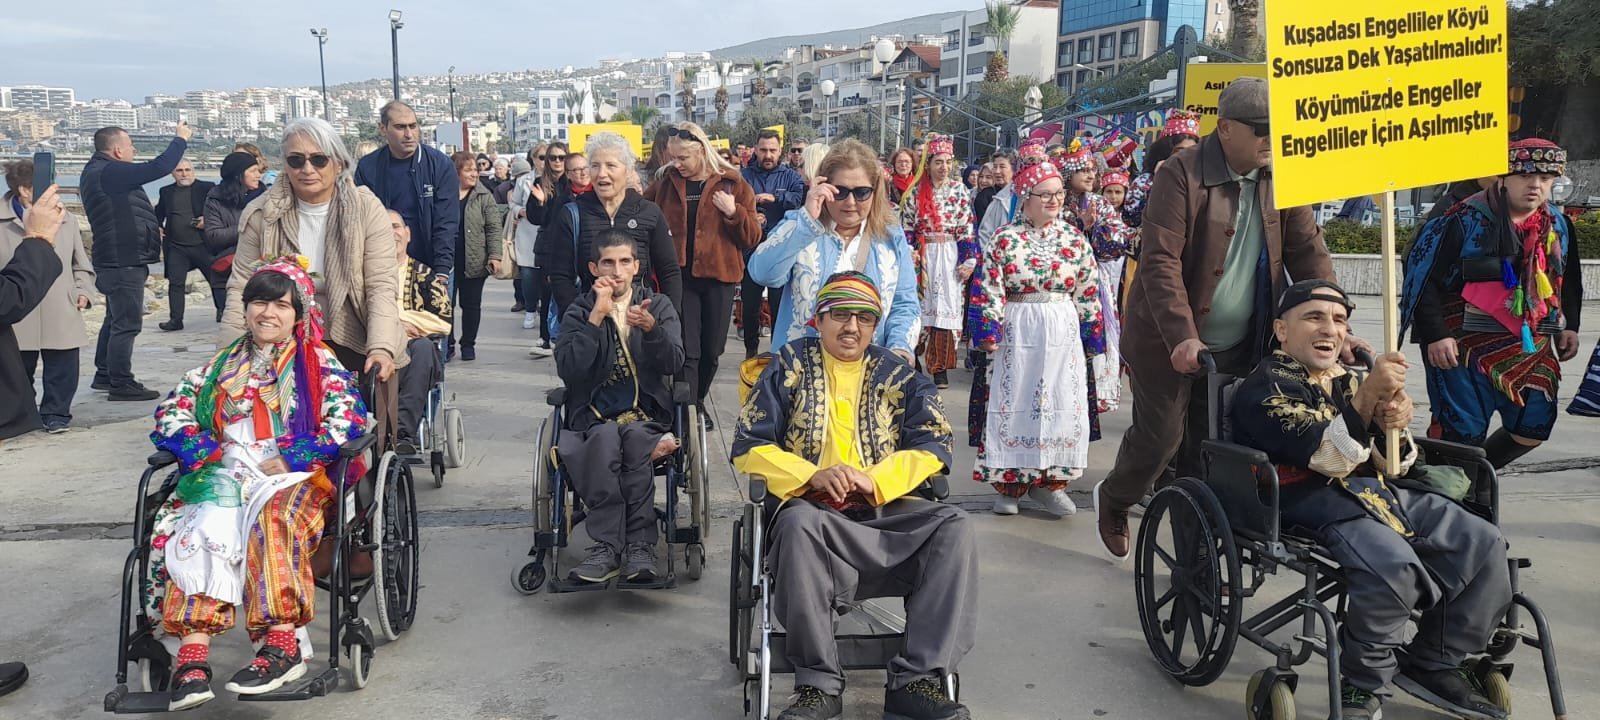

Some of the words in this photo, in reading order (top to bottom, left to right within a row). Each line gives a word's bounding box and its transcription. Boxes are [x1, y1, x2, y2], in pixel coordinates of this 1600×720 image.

[1284, 20, 1361, 47] Kuşadası
[1364, 11, 1444, 39] Engelliler
[1447, 6, 1489, 30] Köyü
[1272, 55, 1344, 78] Sonsuza
[1347, 46, 1381, 70] Dek
[1383, 34, 1502, 66] Yaşatılmalıdır!
[1295, 91, 1404, 122] Köyümüzde
[1407, 79, 1482, 107] Engeller
[1281, 127, 1368, 158] Engelliler
[1371, 118, 1404, 147] İçin
[1408, 111, 1498, 141] Aşılmıştır.
